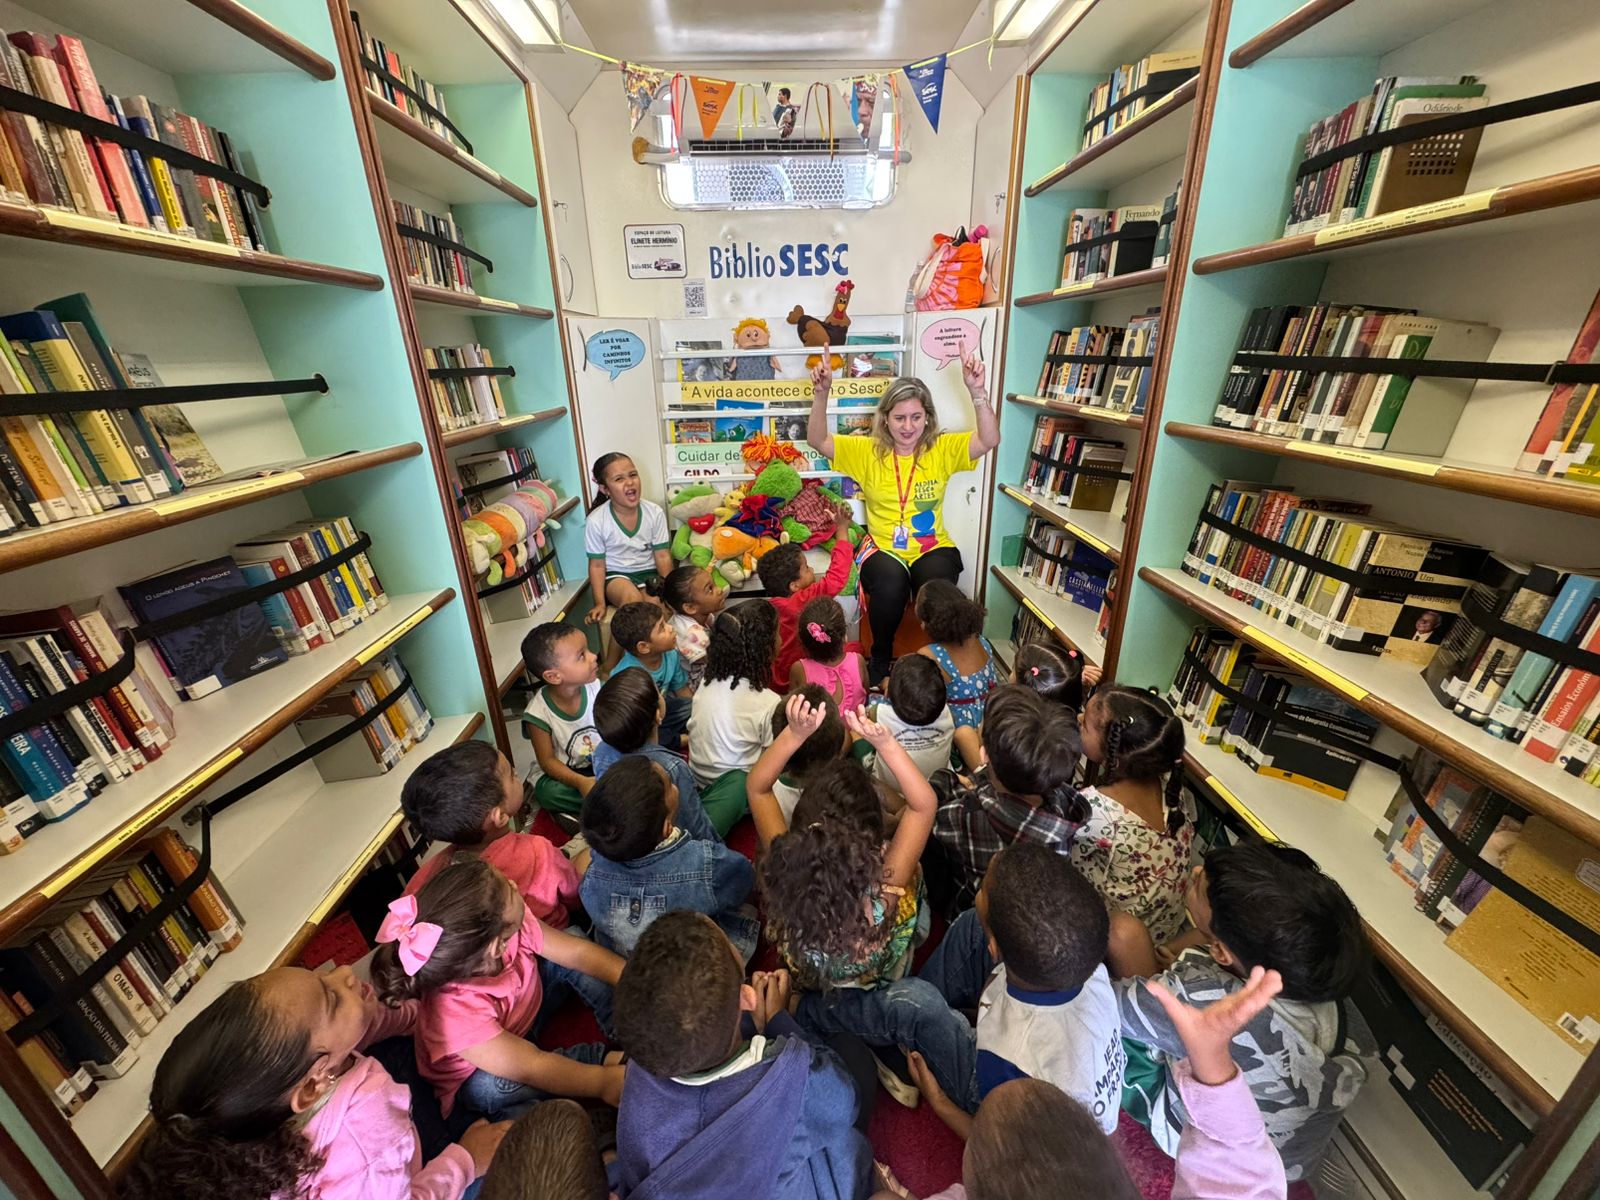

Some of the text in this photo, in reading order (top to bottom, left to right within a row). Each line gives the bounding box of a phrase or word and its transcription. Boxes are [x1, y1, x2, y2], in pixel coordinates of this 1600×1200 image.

[1423, 103, 1432, 112] O
[1126, 209, 1160, 218] Fernando
[709, 242, 850, 279] BiblioSESC
[691, 386, 701, 399] A
[704, 385, 733, 398] vida
[736, 384, 803, 397] acontece
[837, 386, 846, 395] o
[677, 450, 720, 462] Cuidar
[724, 450, 741, 461] de
[1373, 566, 1434, 582] ANTONIO Um
[1550, 670, 1592, 727] Ensaios Econôm
